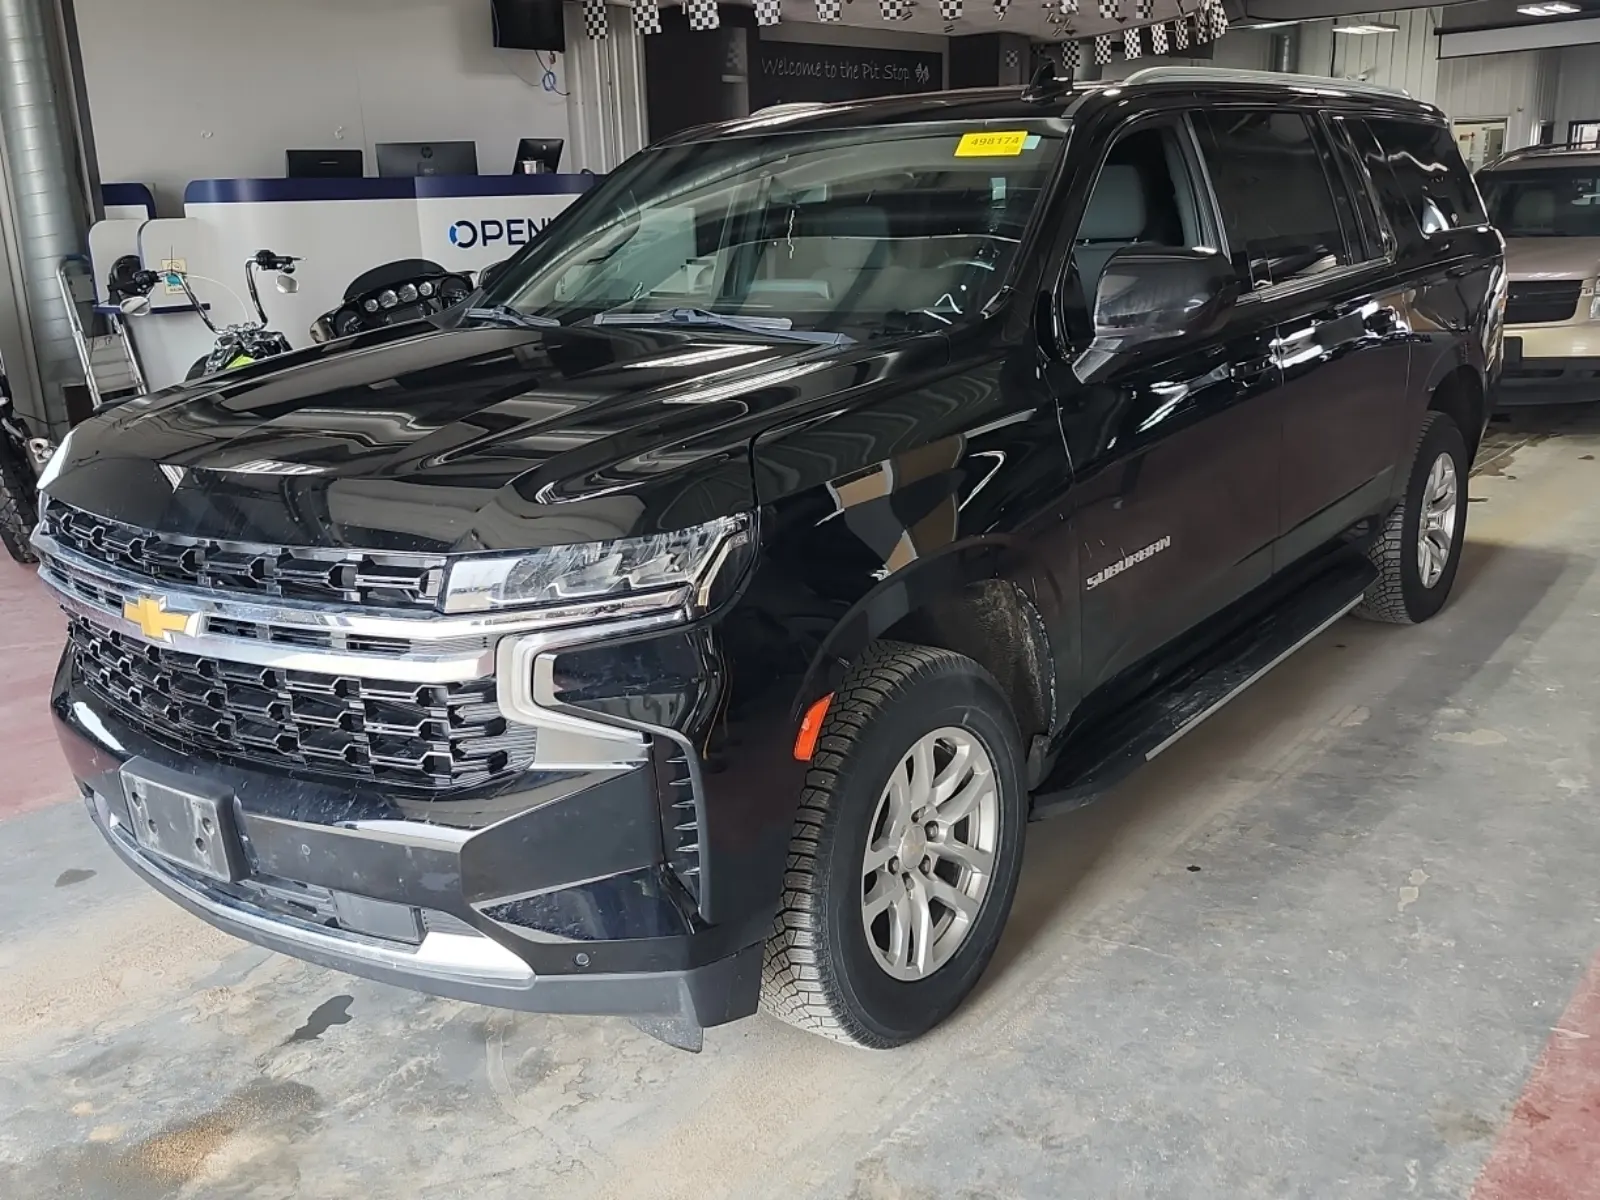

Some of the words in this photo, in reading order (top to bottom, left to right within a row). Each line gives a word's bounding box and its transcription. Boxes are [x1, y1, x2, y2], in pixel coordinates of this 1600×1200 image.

[761, 57, 822, 77] Welcome
[824, 62, 837, 79] to
[840, 60, 859, 80] the
[861, 60, 880, 80] Pit
[883, 63, 911, 85] Stop
[970, 136, 1020, 146] 498174
[449, 218, 552, 249] OPEN
[1086, 535, 1171, 591] SUBURBAN
